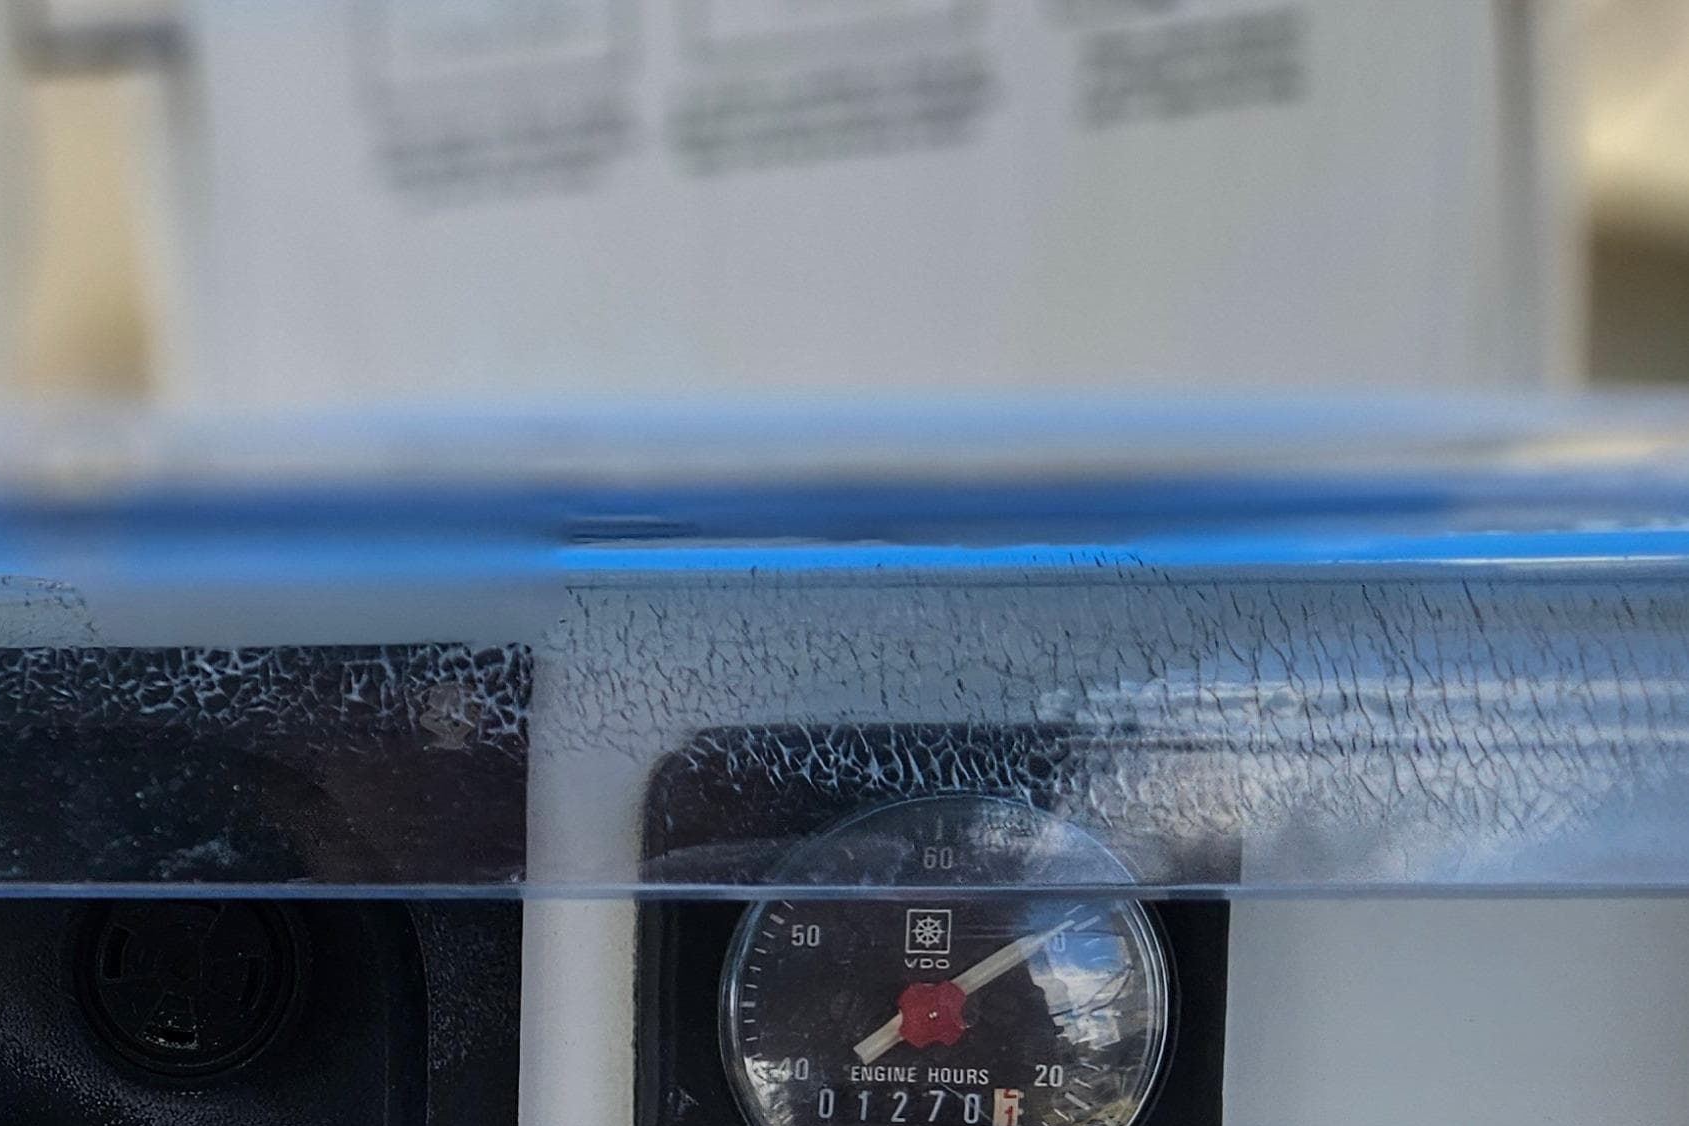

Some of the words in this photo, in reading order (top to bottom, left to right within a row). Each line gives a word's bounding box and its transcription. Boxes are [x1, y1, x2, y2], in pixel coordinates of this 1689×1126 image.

[922, 846, 954, 870] 60
[790, 924, 821, 948] 50
[903, 957, 951, 970] VDO
[850, 1065, 917, 1084] ENGINE
[927, 1066, 990, 1085] HOURS
[1033, 1064, 1065, 1088] 20
